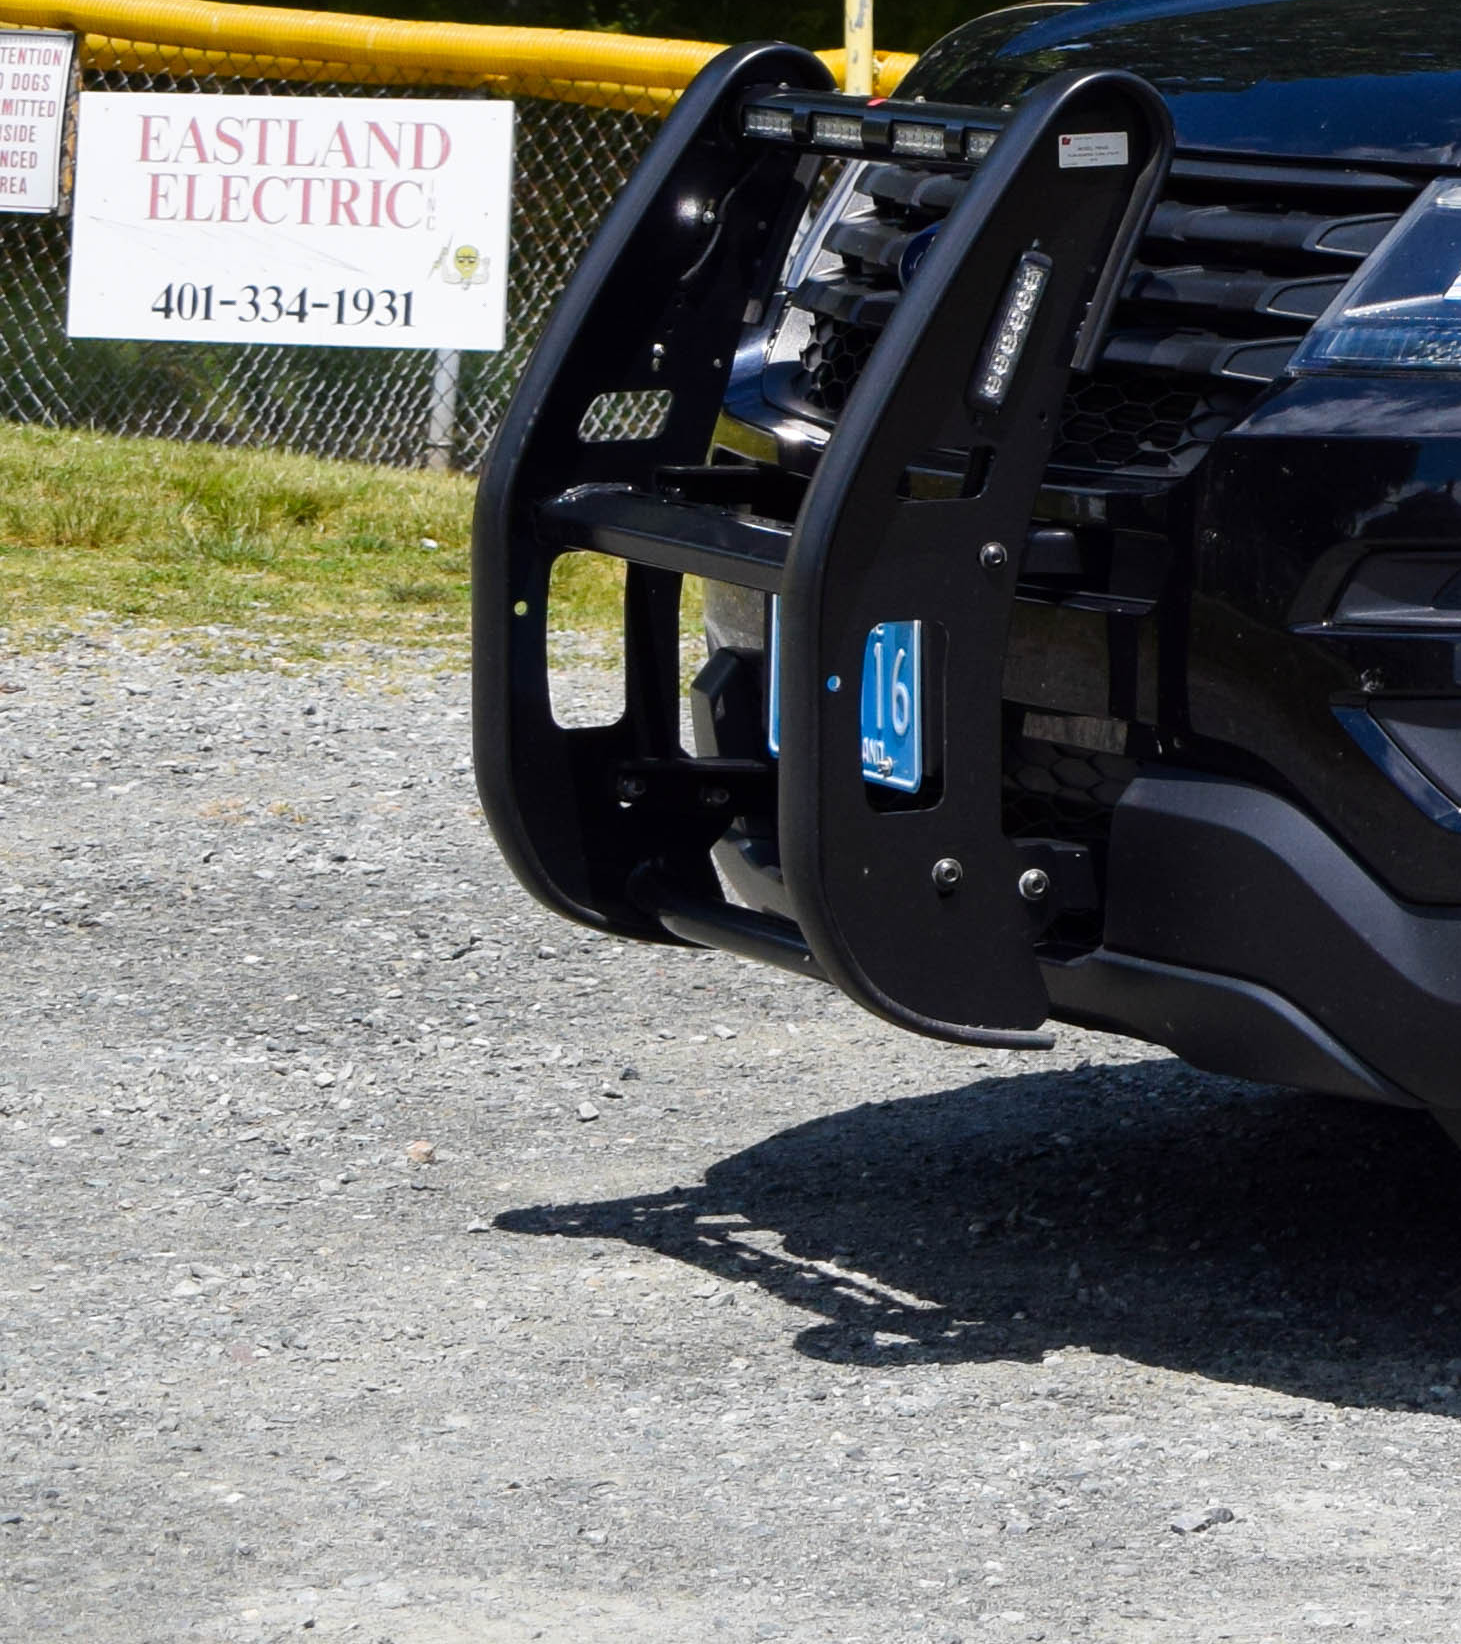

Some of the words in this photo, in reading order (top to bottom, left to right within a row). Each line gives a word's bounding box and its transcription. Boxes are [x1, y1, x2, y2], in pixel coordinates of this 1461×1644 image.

[0, 46, 63, 66] TENTION
[12, 72, 51, 92] DOGS
[1, 98, 56, 118] MITTED
[0, 124, 37, 143] SIDE
[136, 113, 452, 170] EASTLAND
[146, 172, 424, 229] ELECTRIC
[151, 282, 416, 327] 401-334-1931
